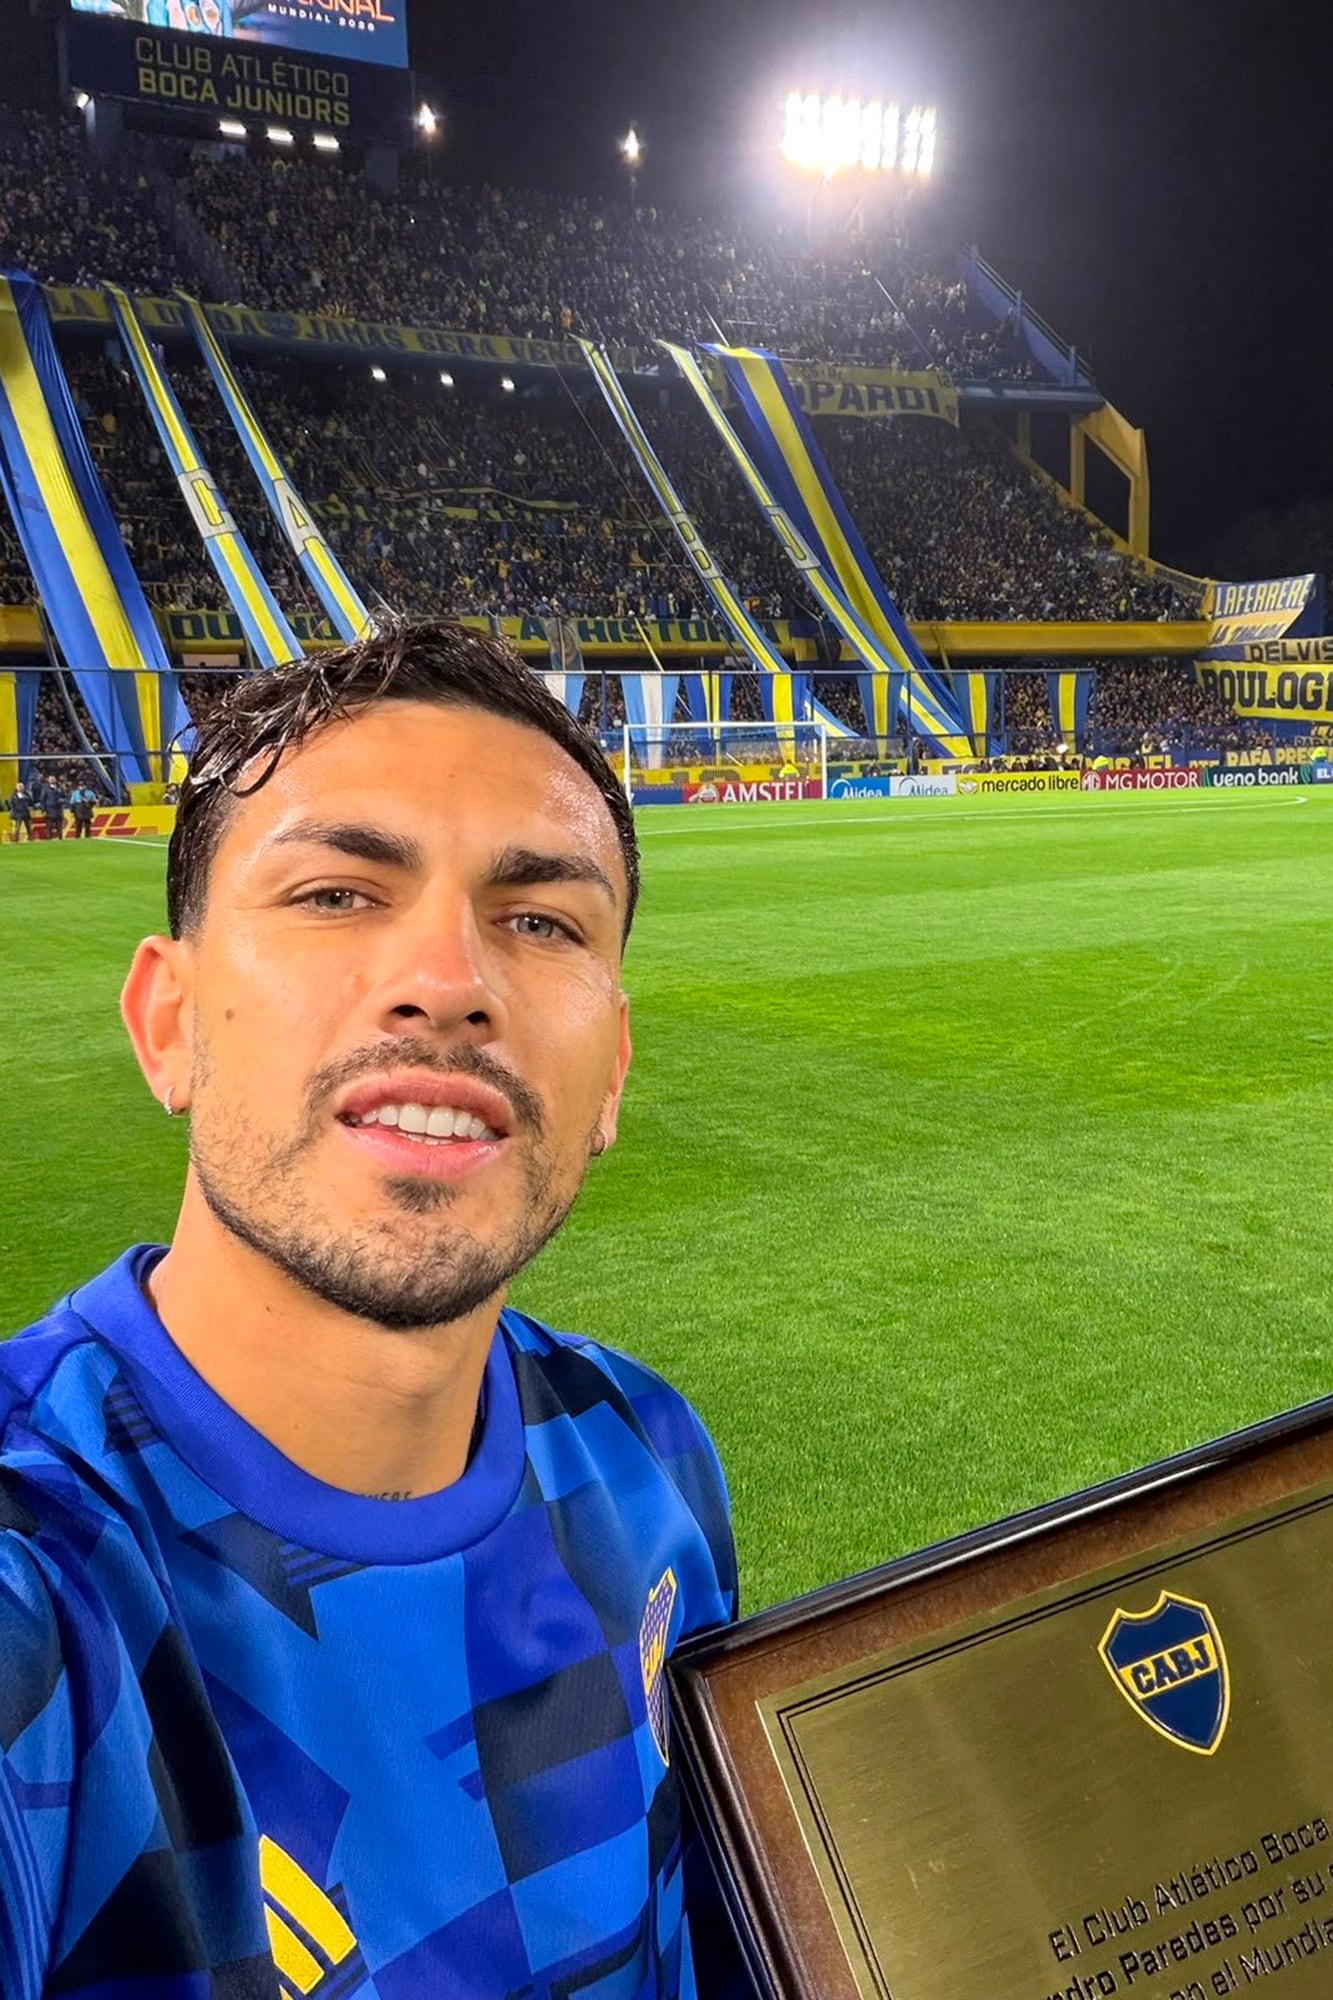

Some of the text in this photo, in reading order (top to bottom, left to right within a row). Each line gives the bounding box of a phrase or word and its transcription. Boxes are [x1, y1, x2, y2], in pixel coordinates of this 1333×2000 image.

[268, 3, 331, 23] MUNDIAL
[135, 36, 349, 97] CLUB ATLÉTICO
[138, 67, 350, 126] BOCA JUNIORS
[1215, 578, 1310, 616] LAFERRERE
[1201, 669, 1333, 711] BOULOG
[1213, 767, 1299, 787] ueno bank
[1226, 751, 1273, 768] RAFA
[842, 784, 882, 799] Midea
[909, 784, 948, 797] Midea
[982, 775, 1079, 793] mercado libre
[1105, 773, 1133, 790] MG
[1136, 771, 1198, 791] MOTOR
[1130, 1639, 1211, 1695] CABJ
[1048, 1818, 1330, 1963] El Club Atlético Boca
[1118, 1913, 1239, 1985] Paredes
[1241, 1887, 1287, 1935] por
[1291, 1872, 1328, 1904] su
[1211, 1959, 1239, 1997] el
[1239, 1917, 1333, 1984] Mundia
